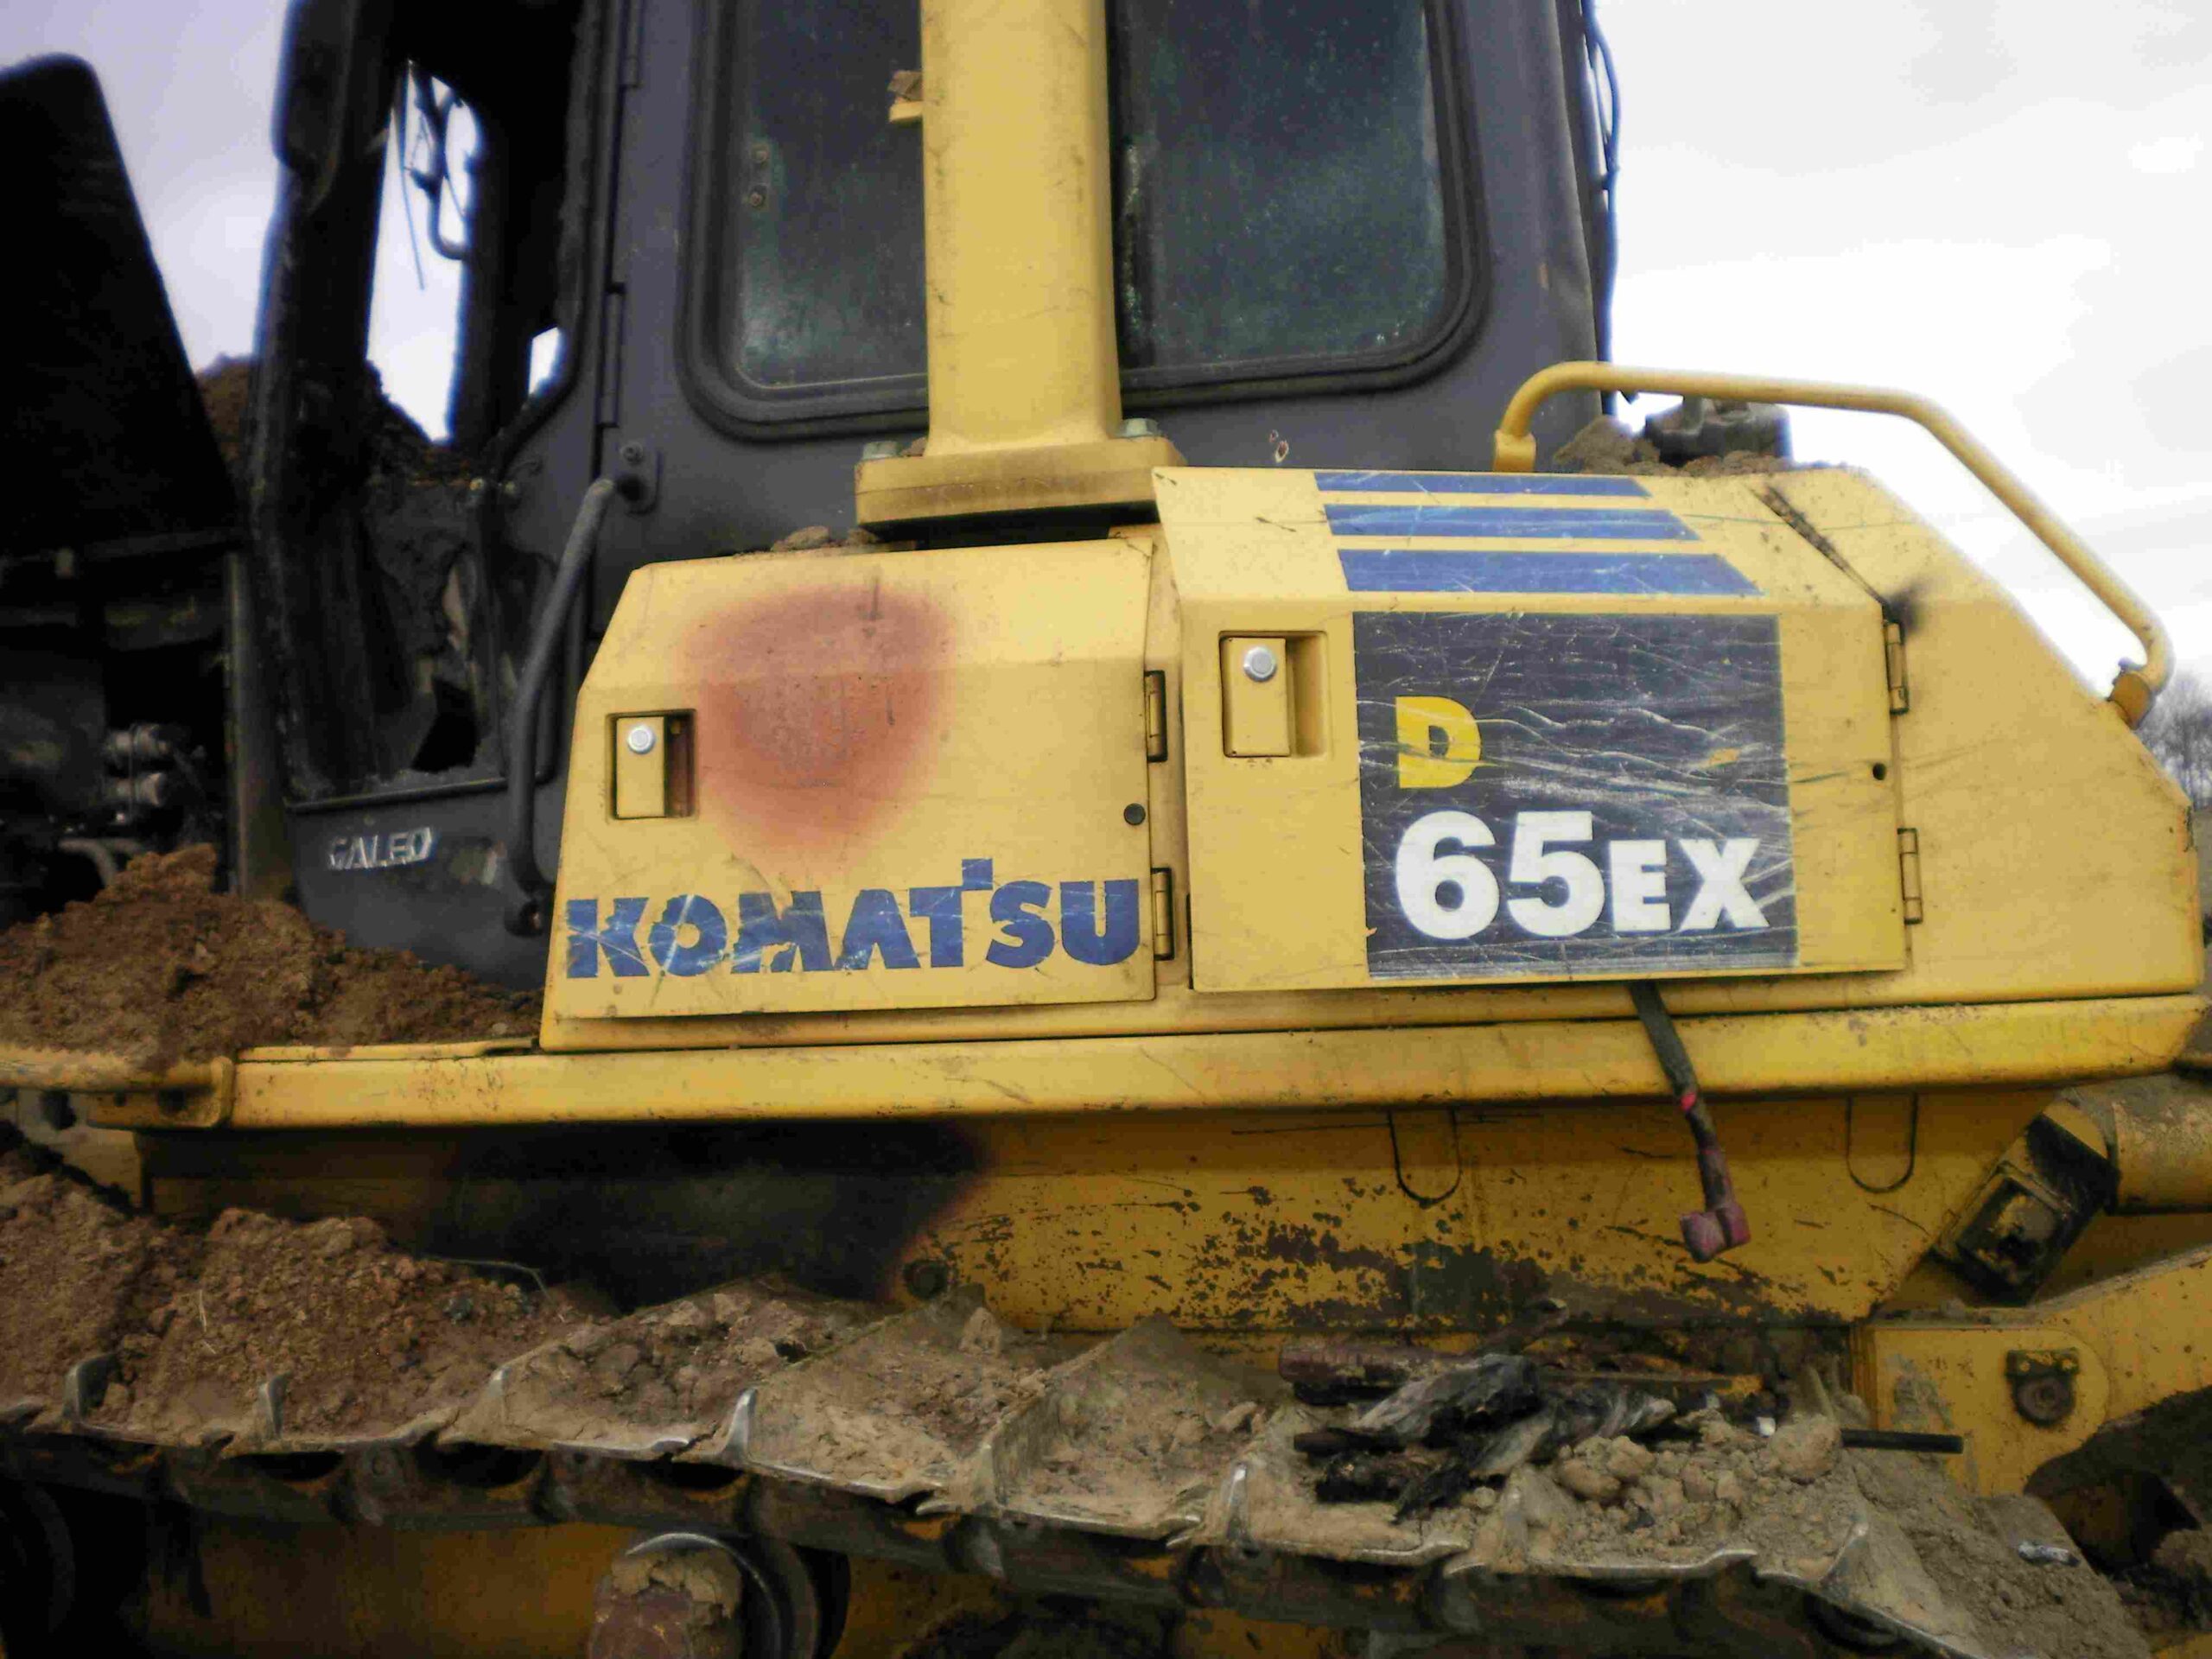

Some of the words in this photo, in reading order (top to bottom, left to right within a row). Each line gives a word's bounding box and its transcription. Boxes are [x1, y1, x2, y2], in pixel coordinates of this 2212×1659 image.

[1395, 696, 1481, 788] D
[566, 858, 1141, 978] KOMATSU
[1395, 810, 1770, 939] 65EX
